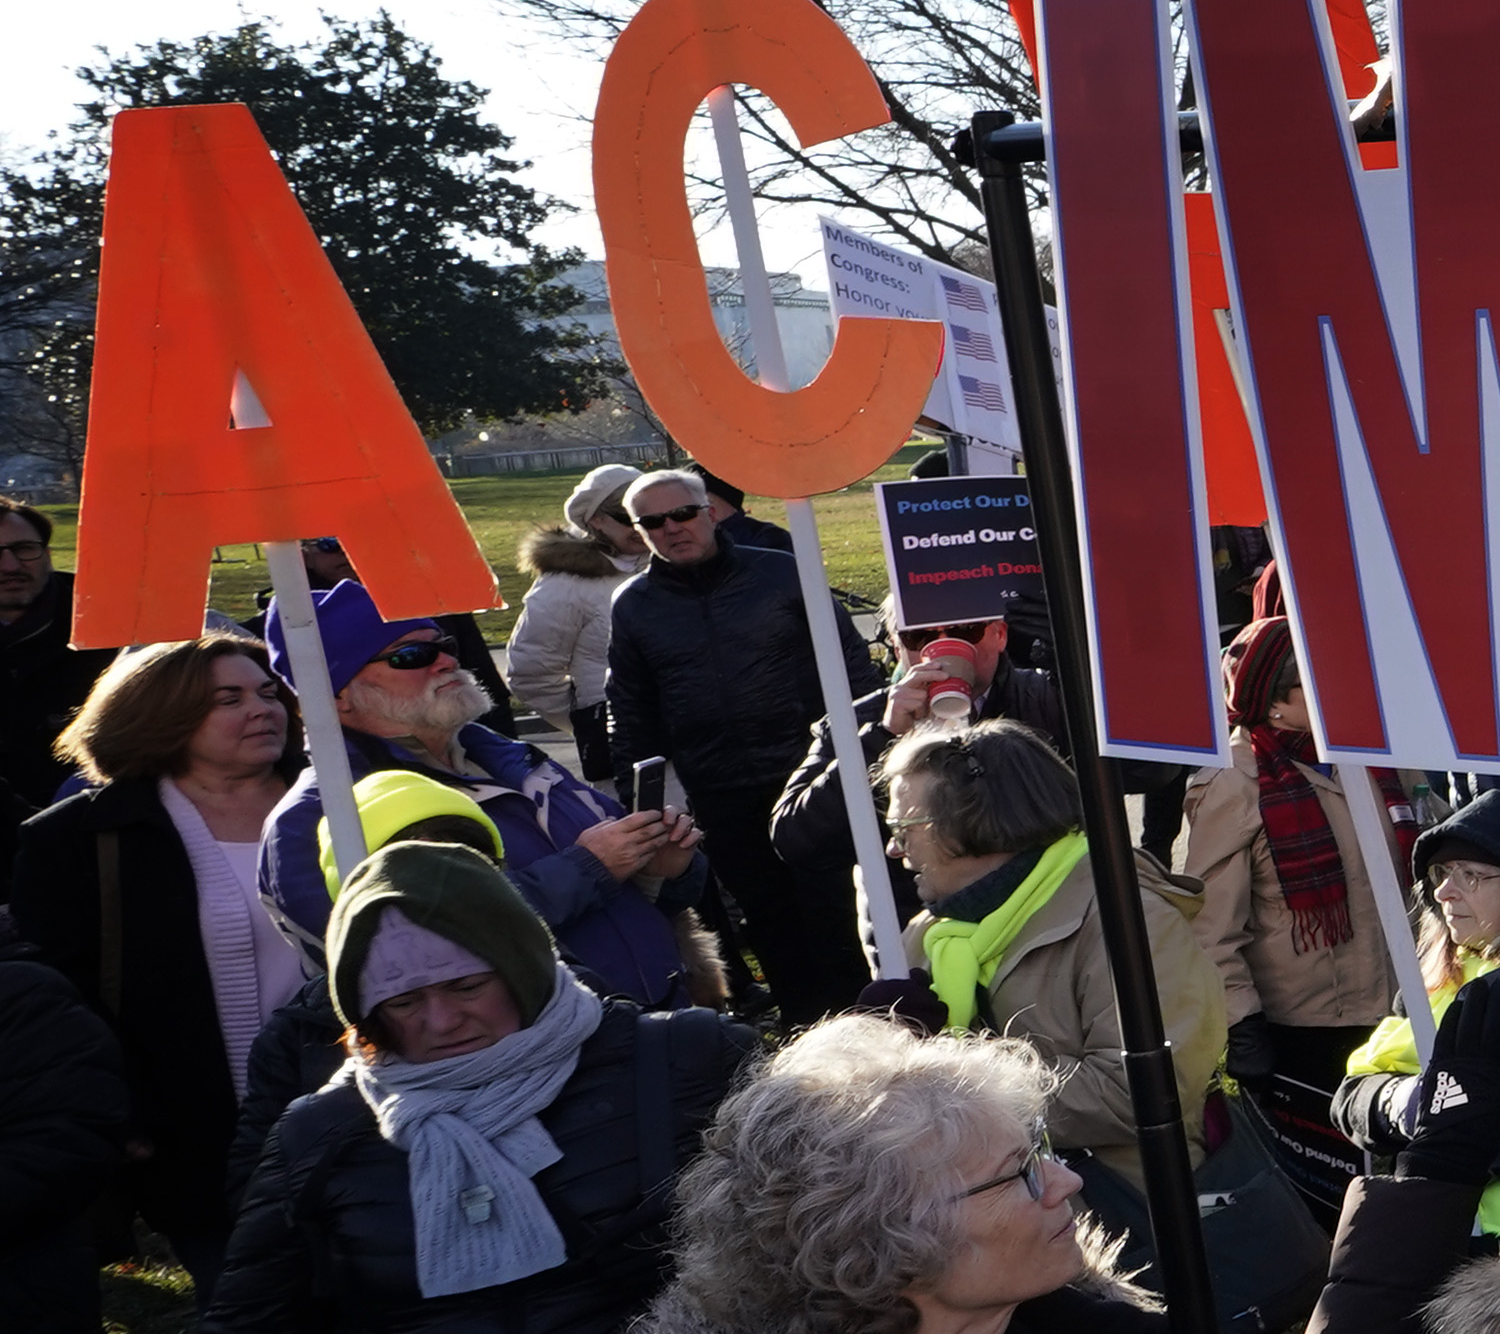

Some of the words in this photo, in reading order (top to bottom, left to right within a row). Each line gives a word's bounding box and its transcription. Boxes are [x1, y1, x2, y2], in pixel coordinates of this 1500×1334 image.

[825, 225, 904, 267] Members
[908, 260, 924, 275] of
[830, 253, 911, 294] Congress:
[835, 282, 892, 313] Honor
[897, 496, 972, 514] Protect
[974, 495, 1011, 508] Our
[902, 530, 976, 550] Defend
[978, 528, 1016, 543] Our
[908, 564, 994, 585] Impeach
[1430, 1071, 1449, 1115] adidas
